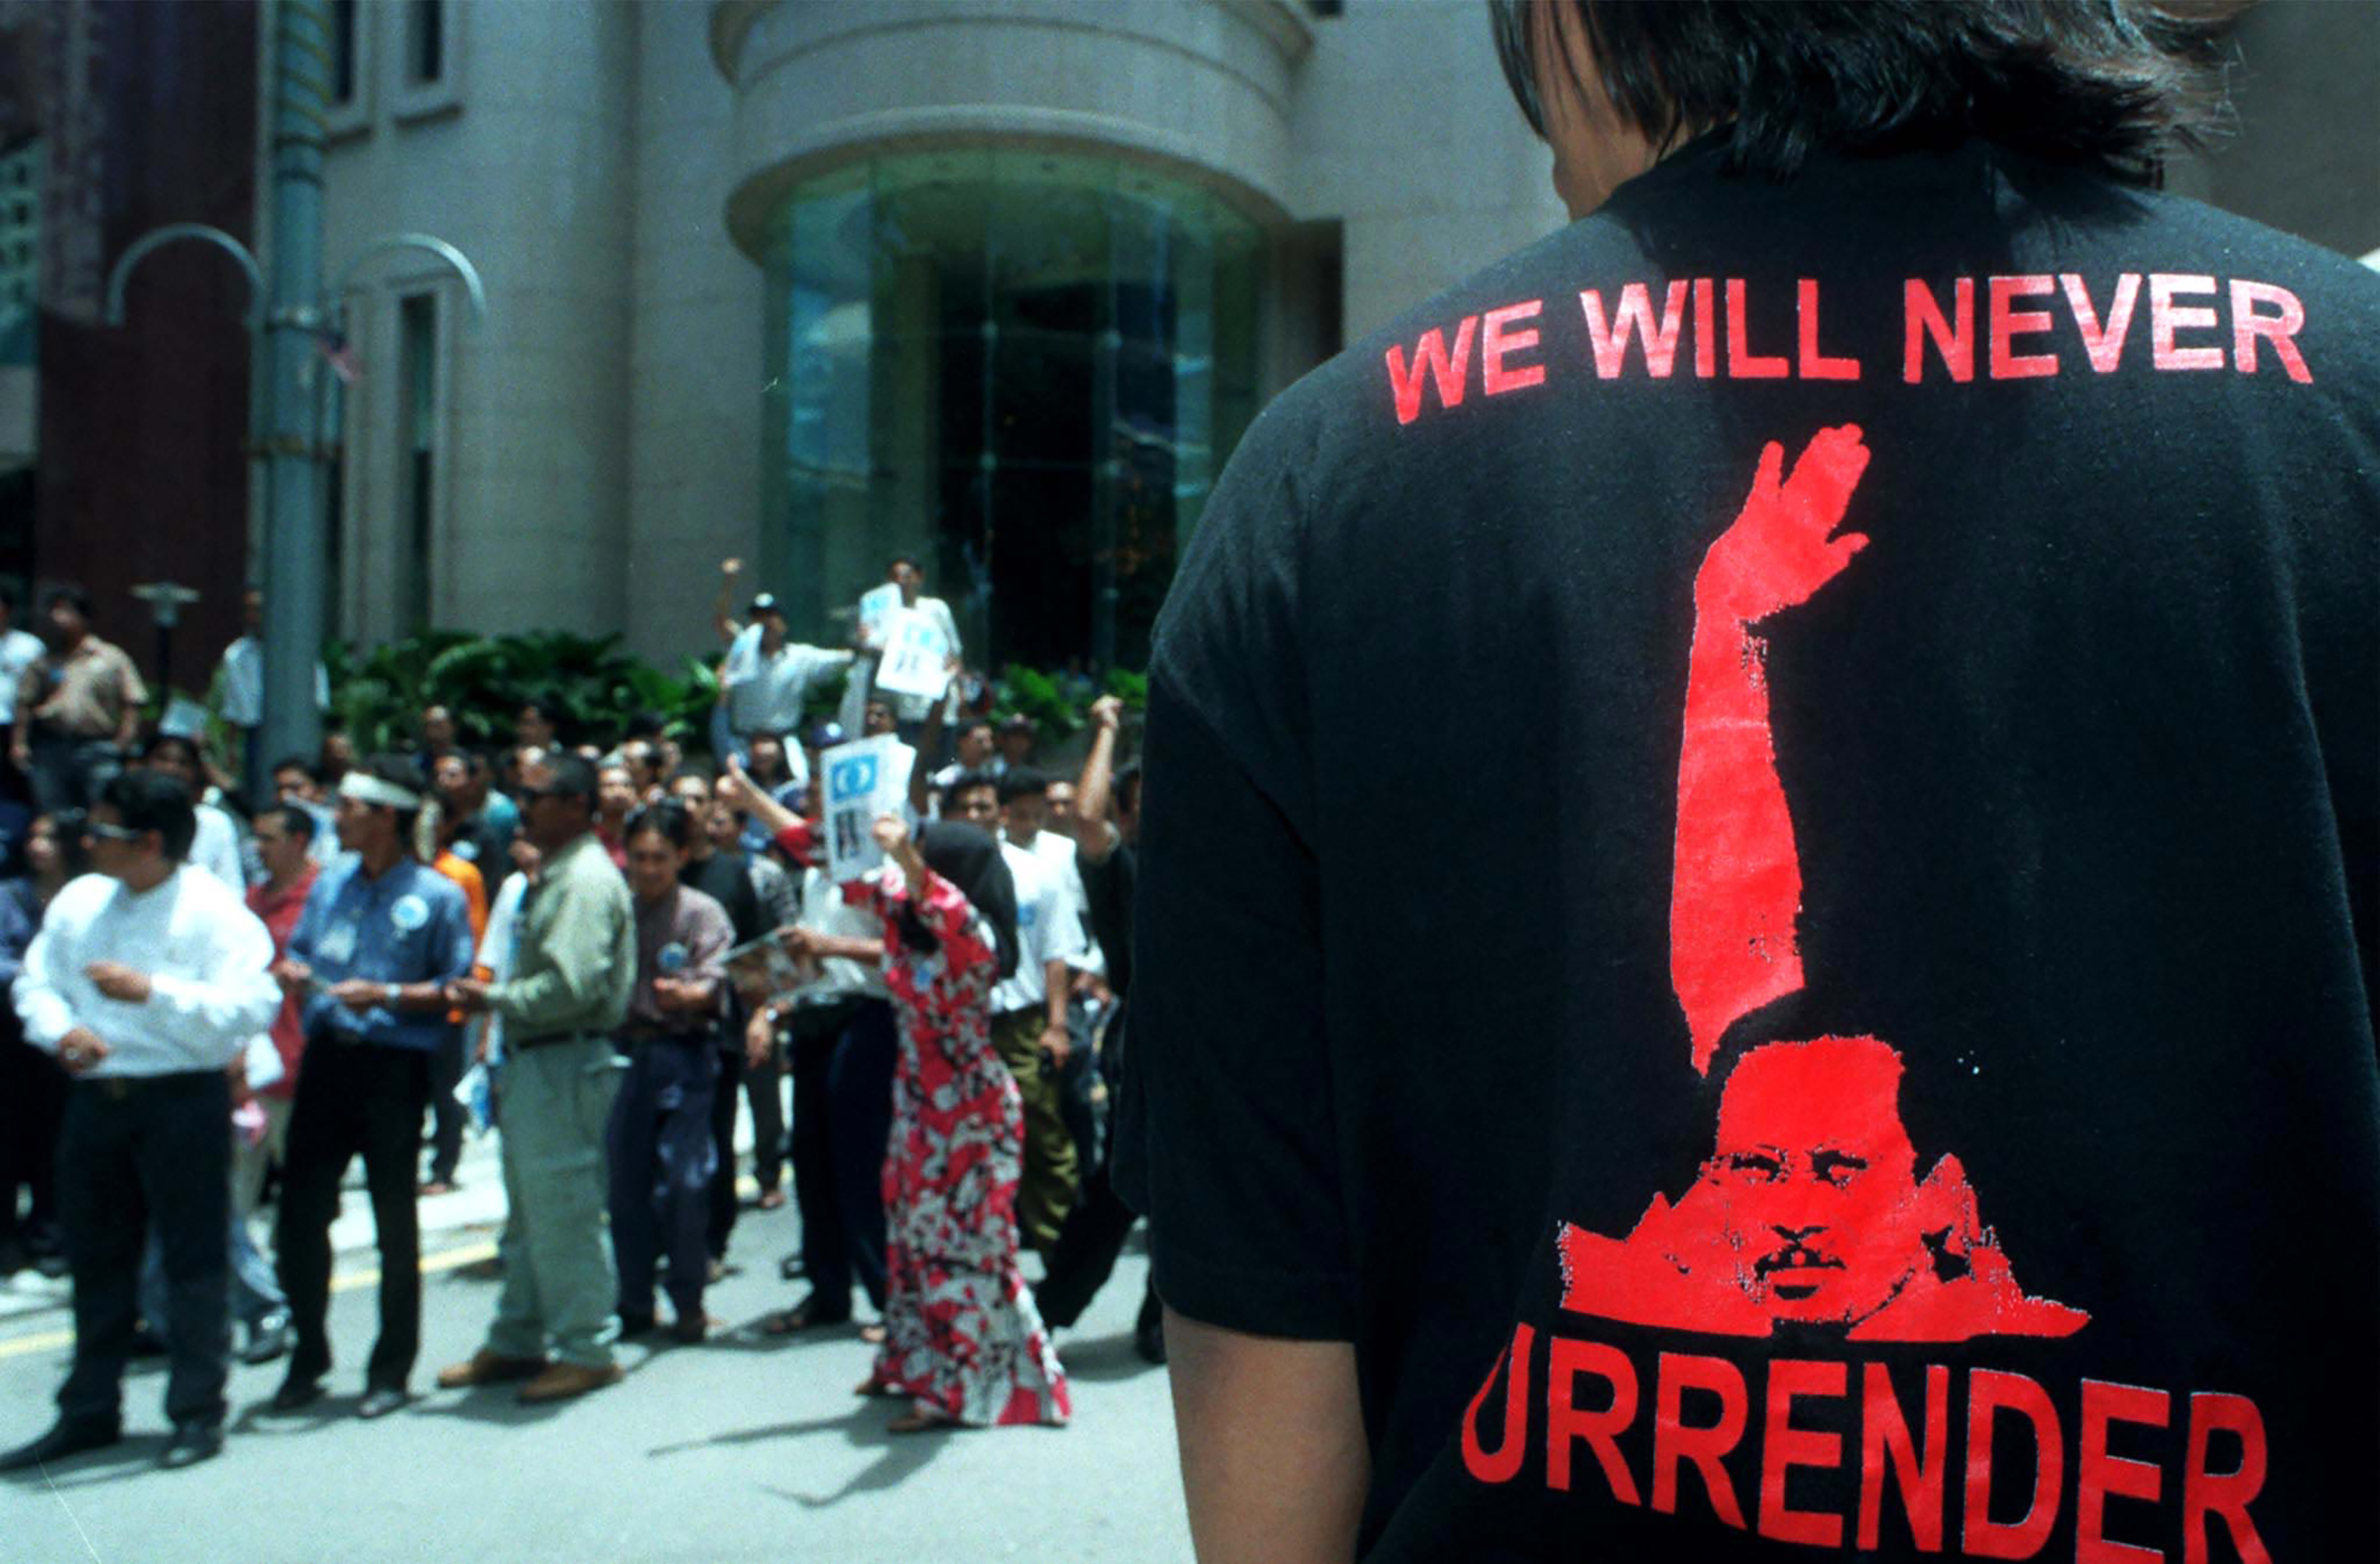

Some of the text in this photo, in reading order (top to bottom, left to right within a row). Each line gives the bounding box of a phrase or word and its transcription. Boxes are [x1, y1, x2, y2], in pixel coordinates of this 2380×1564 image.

[1384, 274, 2314, 424] WE WILL NEVER
[1461, 1322, 2272, 1564] URRENDER
